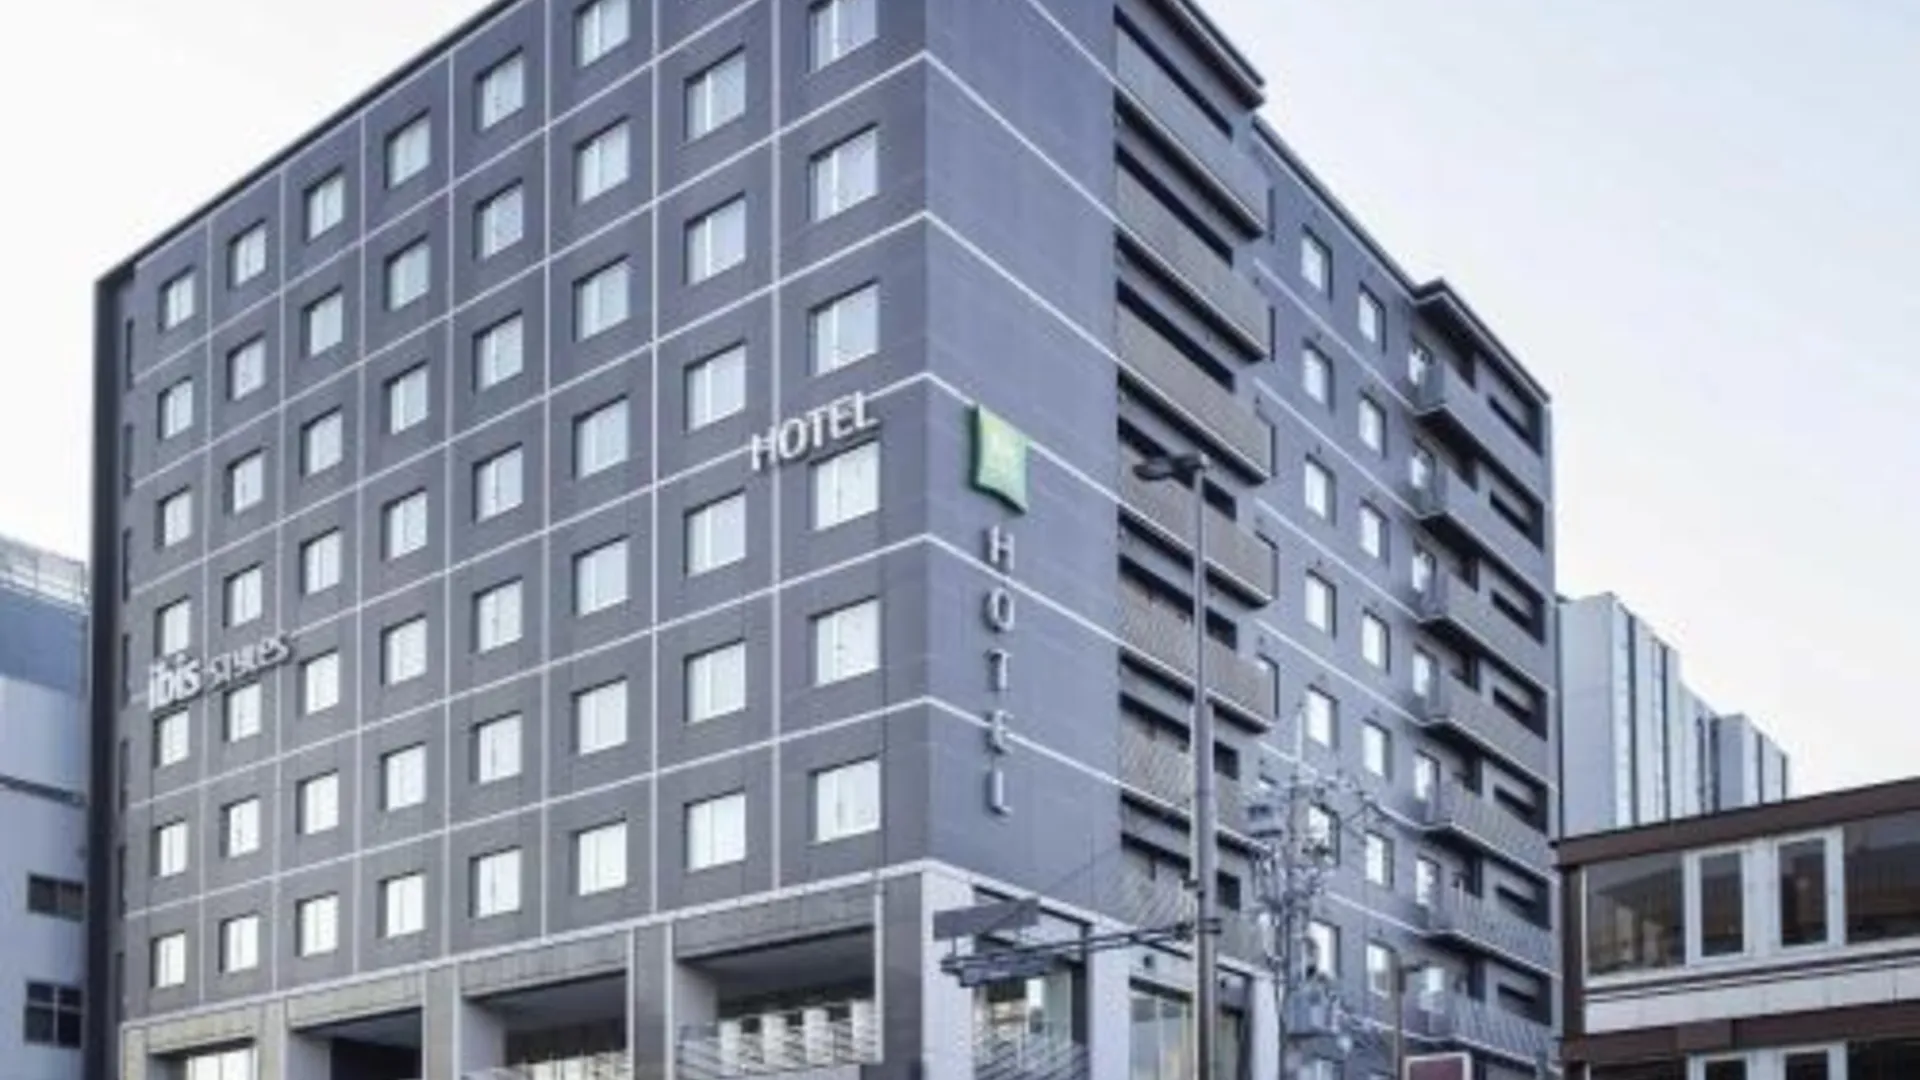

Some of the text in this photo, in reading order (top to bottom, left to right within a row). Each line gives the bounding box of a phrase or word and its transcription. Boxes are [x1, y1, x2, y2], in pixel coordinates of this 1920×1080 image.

[751, 390, 879, 472] HOTEL
[148, 652, 200, 712] ibis
[986, 525, 1015, 816] HOTEL
